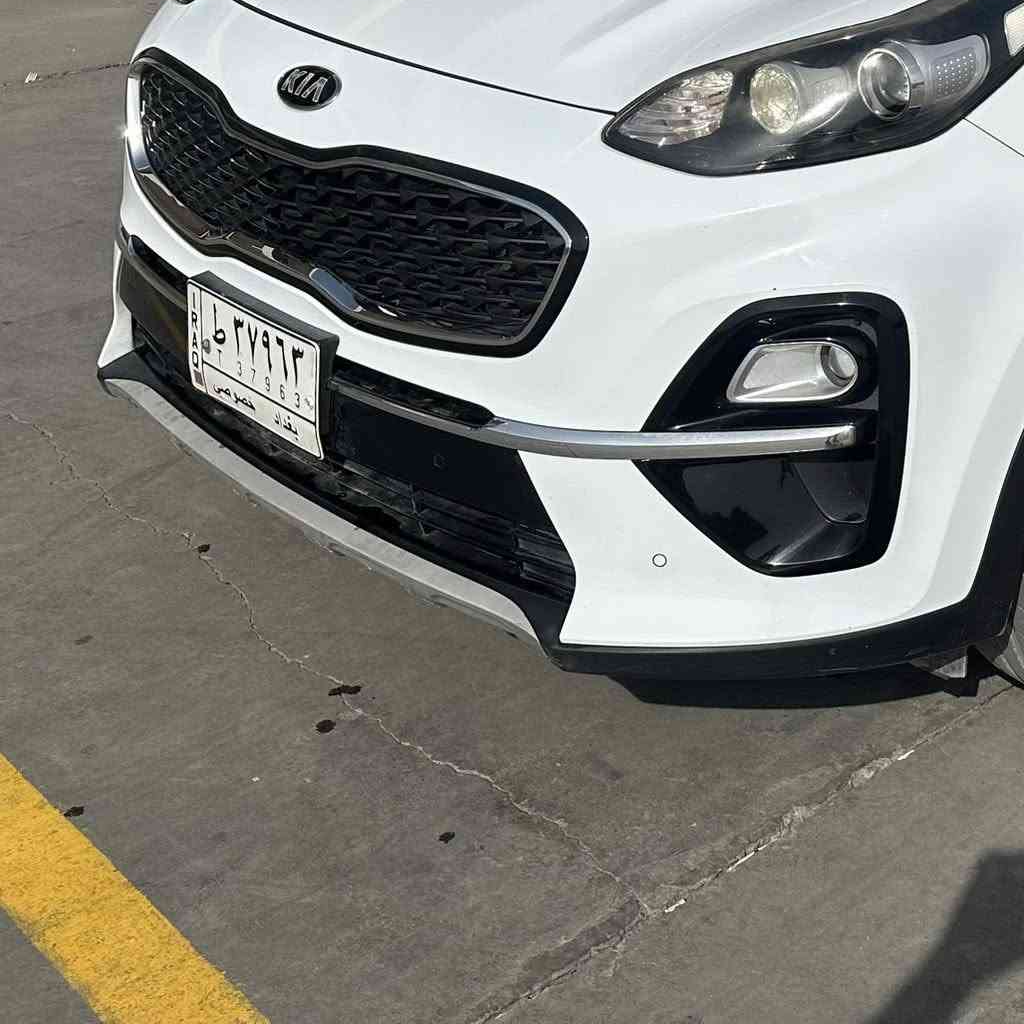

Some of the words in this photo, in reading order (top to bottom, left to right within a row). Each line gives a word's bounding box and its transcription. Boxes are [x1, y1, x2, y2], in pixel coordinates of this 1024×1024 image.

[281, 68, 328, 103] KIA
[190, 291, 199, 370] IRAQ
[212, 303, 227, 345] ط
[233, 314, 305, 388] ٣٧٩٦٣
[217, 349, 222, 368] T
[237, 360, 301, 409] 37963
[273, 411, 299, 441] بغداد
